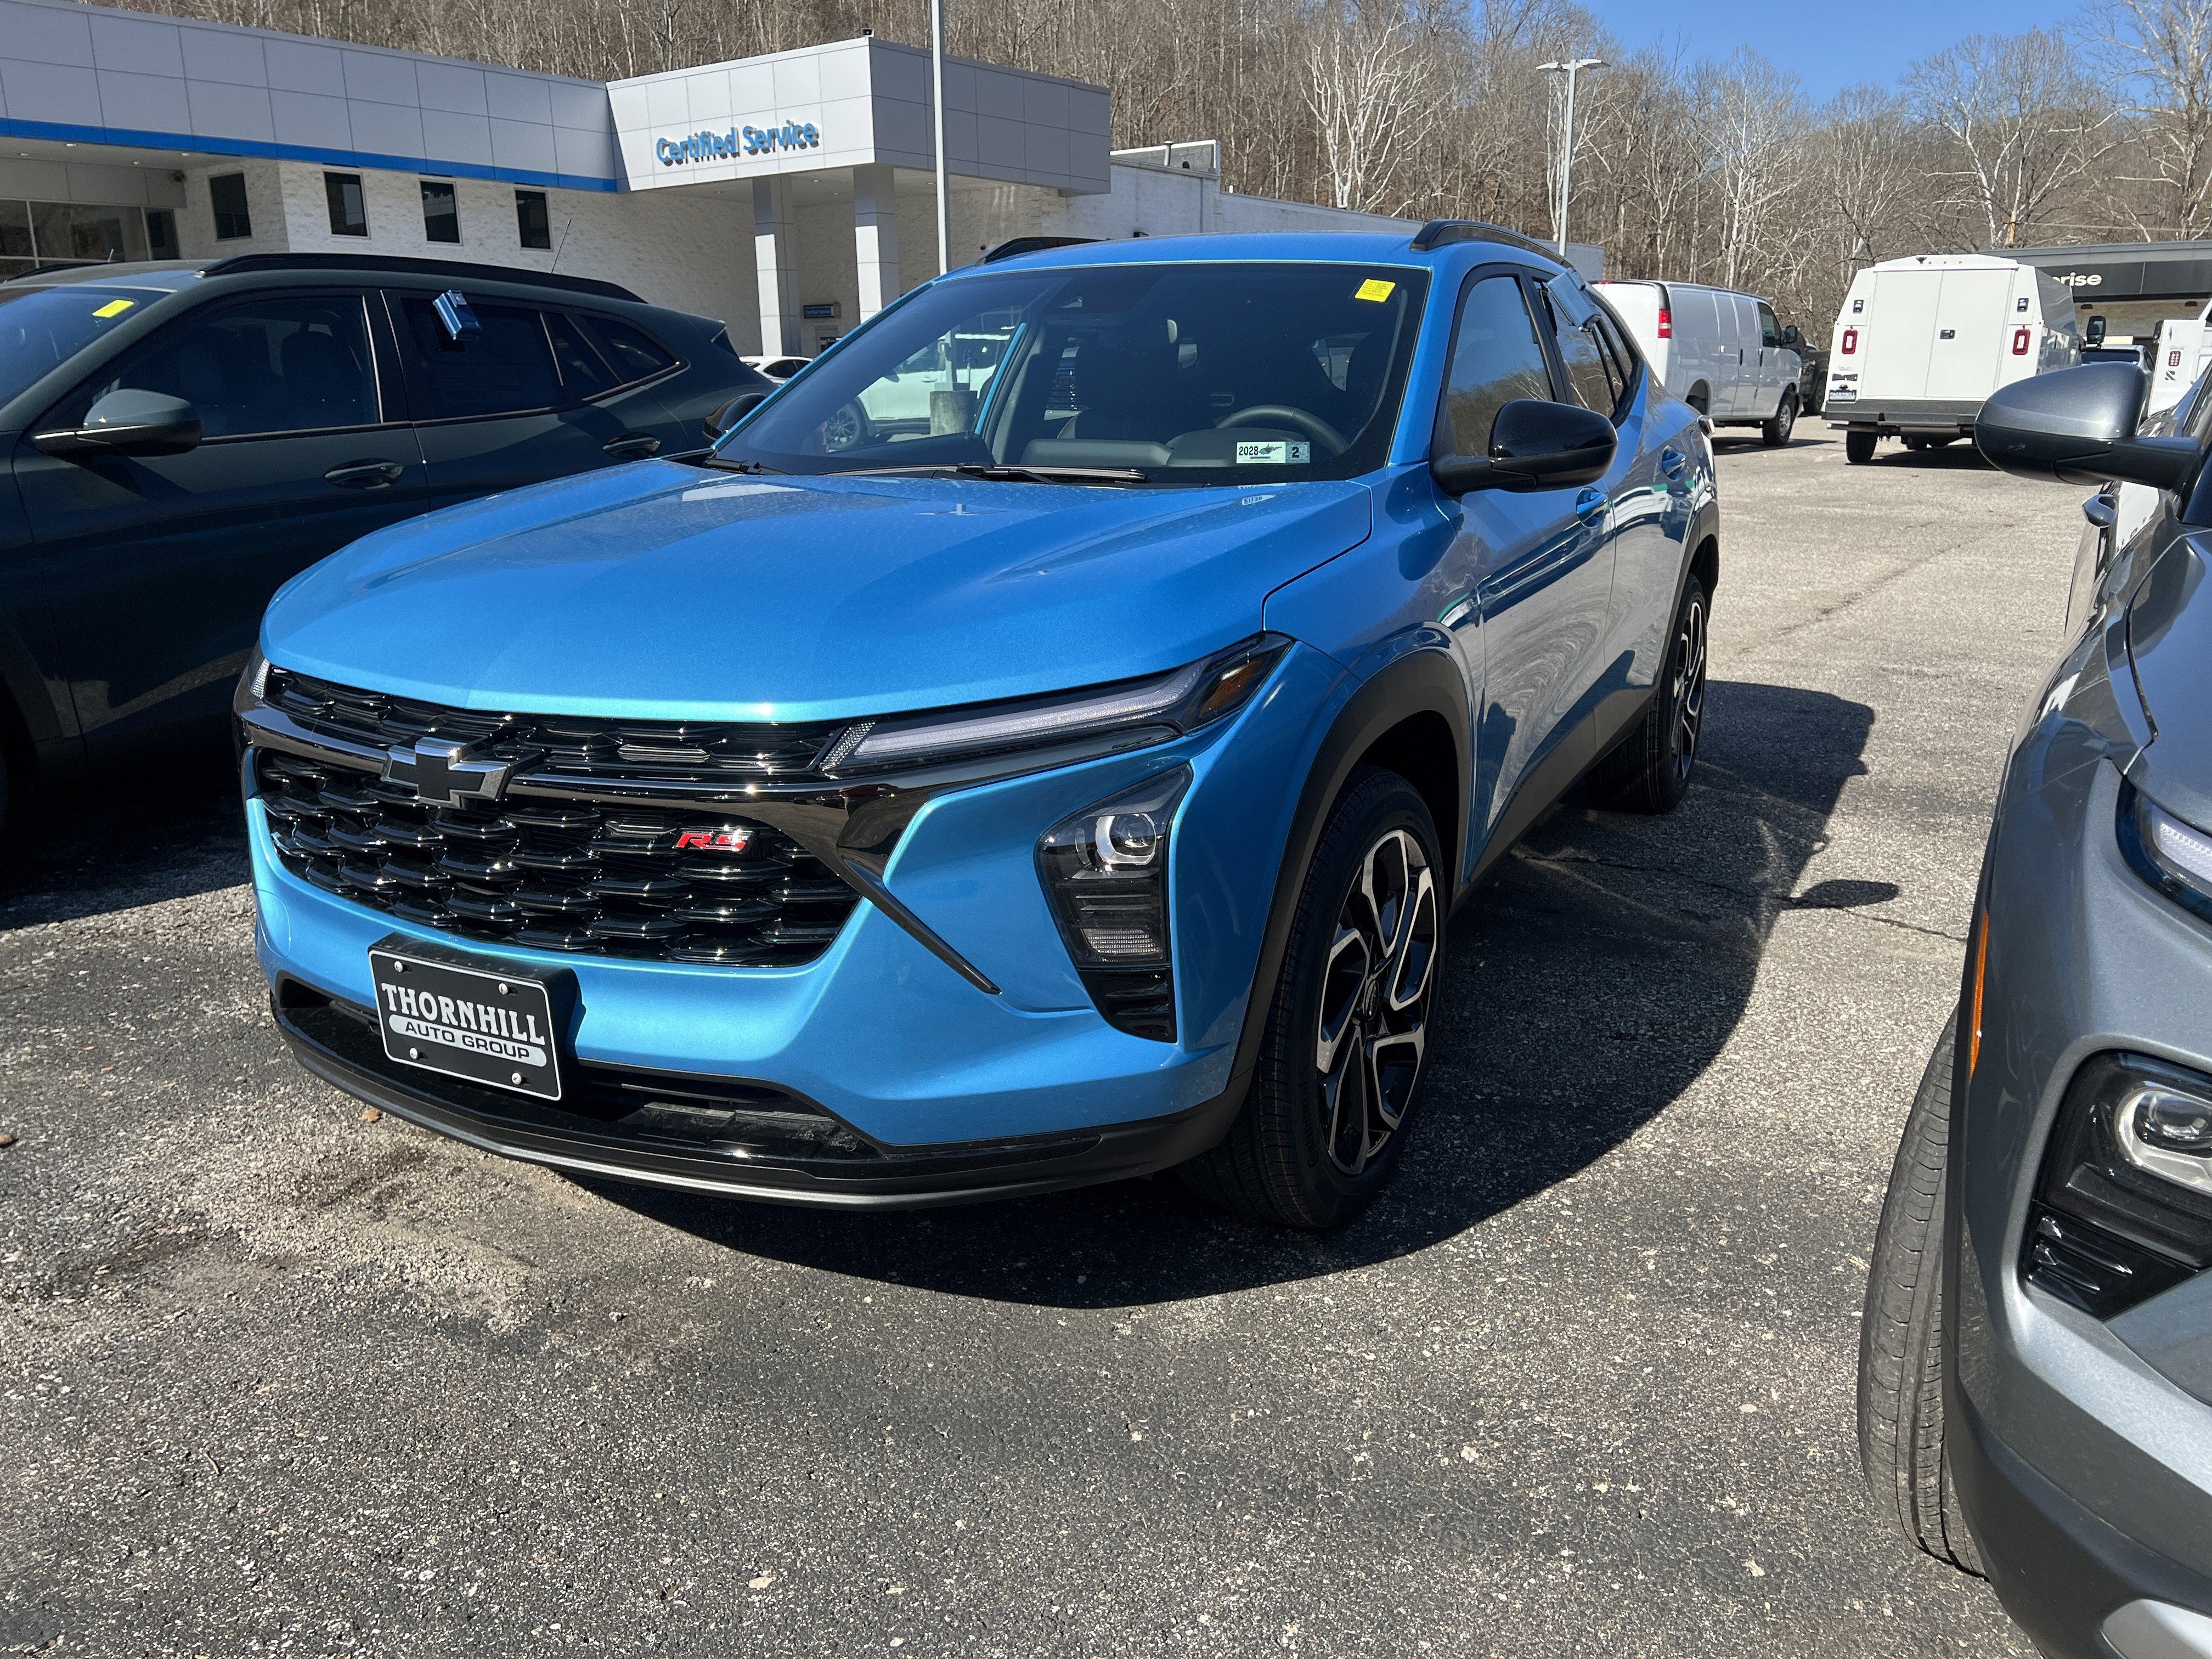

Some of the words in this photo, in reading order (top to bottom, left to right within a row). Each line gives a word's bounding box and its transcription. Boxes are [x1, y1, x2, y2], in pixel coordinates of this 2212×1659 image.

[656, 127, 739, 163] Certified
[743, 119, 819, 151] Service
[2053, 272, 2102, 286] rise
[1239, 445, 1259, 456] 2028
[1292, 446, 1299, 458] 2
[675, 832, 751, 851] RS
[381, 983, 545, 1046] THORNHILL
[405, 1021, 455, 1043] AUTO
[462, 1035, 529, 1059] GROUP
